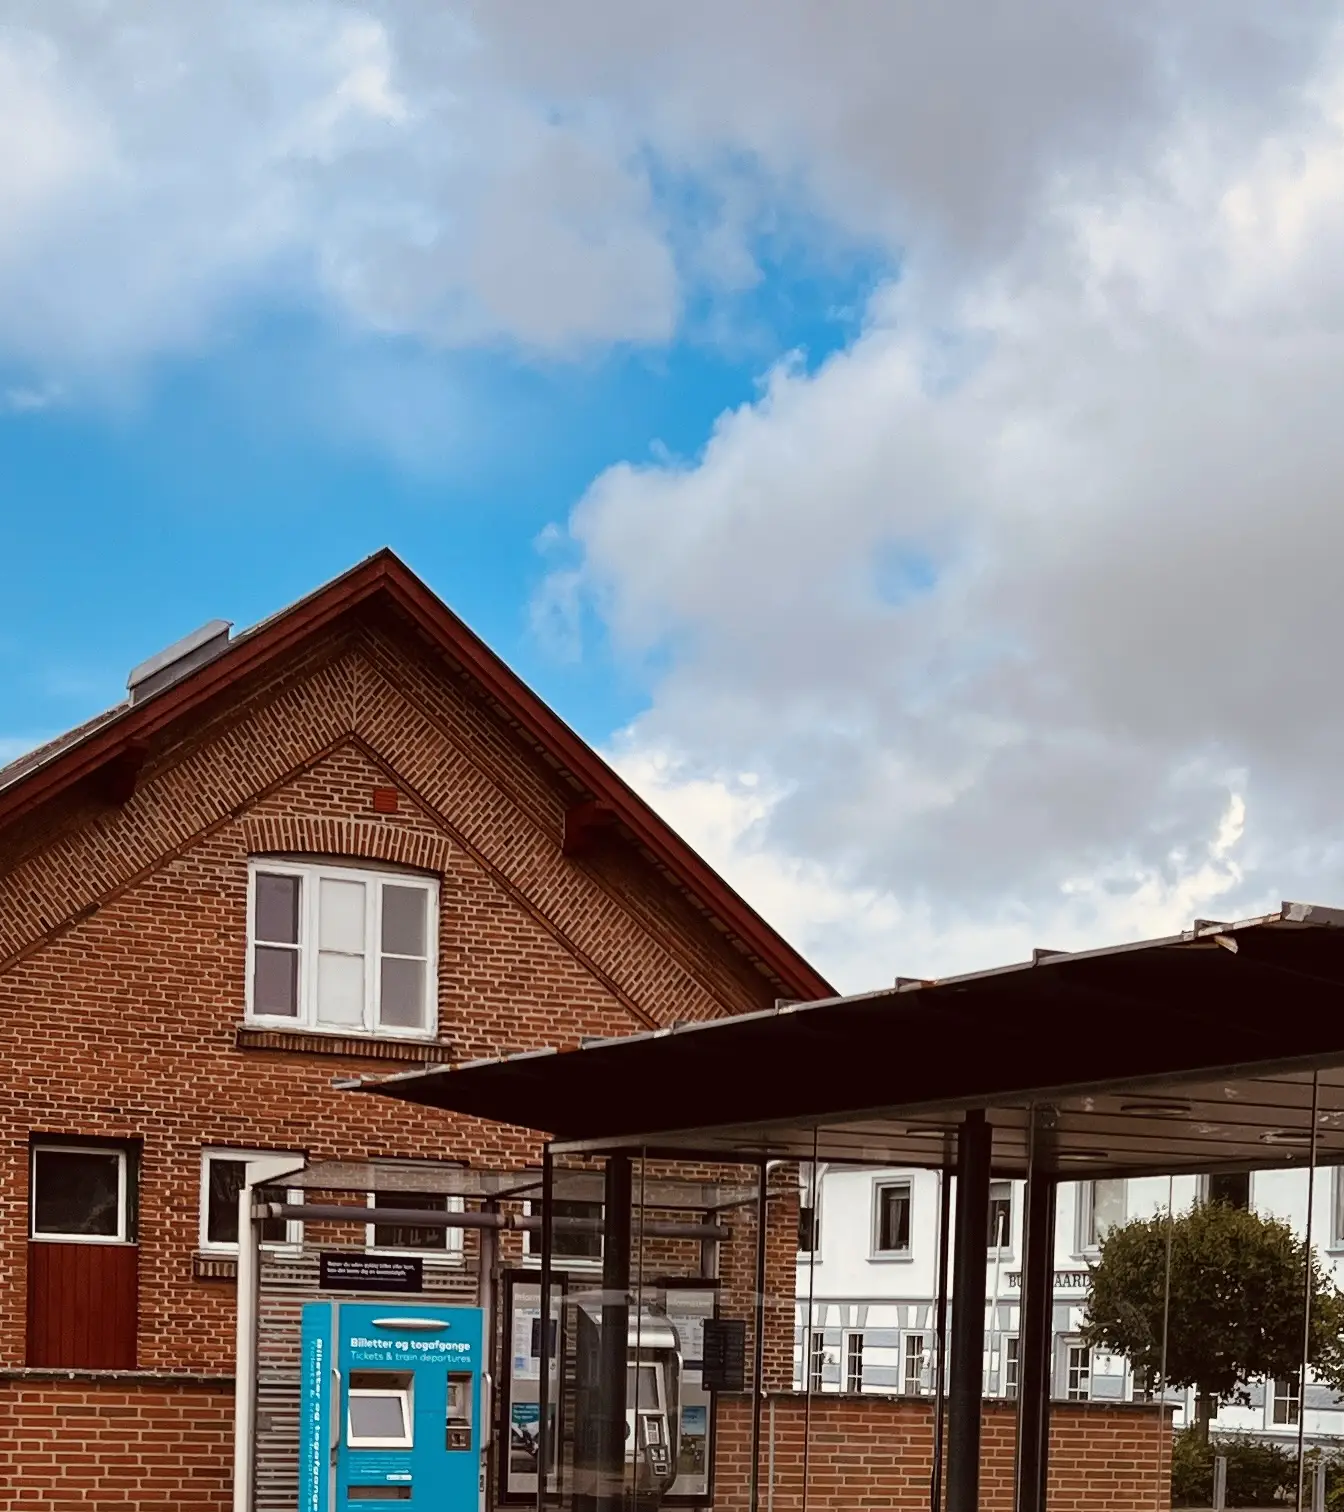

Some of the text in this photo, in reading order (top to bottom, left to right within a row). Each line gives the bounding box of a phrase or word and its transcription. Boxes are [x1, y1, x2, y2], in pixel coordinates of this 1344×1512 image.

[350, 1337, 471, 1353] Billetter og togafgange
[350, 1350, 471, 1363] Tickets & train departures
